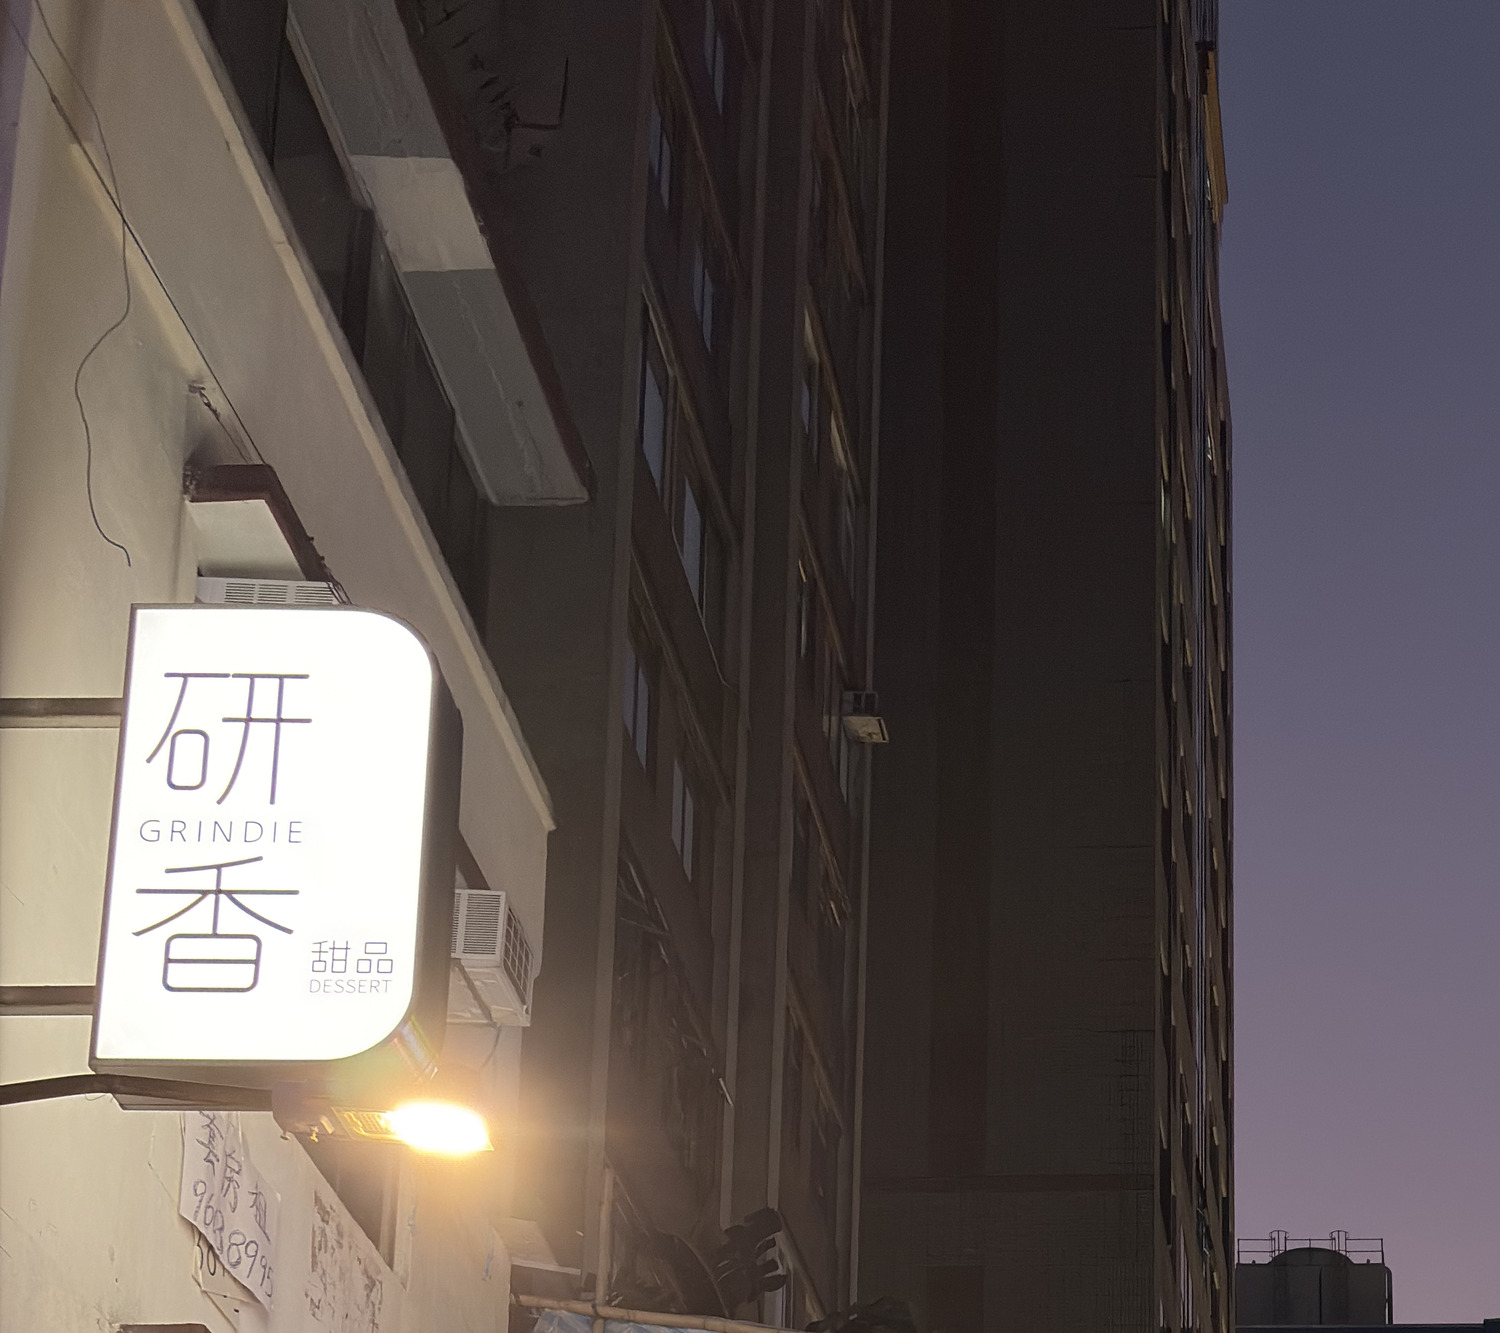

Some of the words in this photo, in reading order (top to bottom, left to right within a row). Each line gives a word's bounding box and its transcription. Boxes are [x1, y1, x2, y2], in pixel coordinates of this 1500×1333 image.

[146, 672, 312, 805] 研
[139, 819, 304, 844] GRINDIE
[132, 856, 300, 993] 香
[310, 940, 394, 975] 甜品
[309, 978, 392, 995] DESSERT
